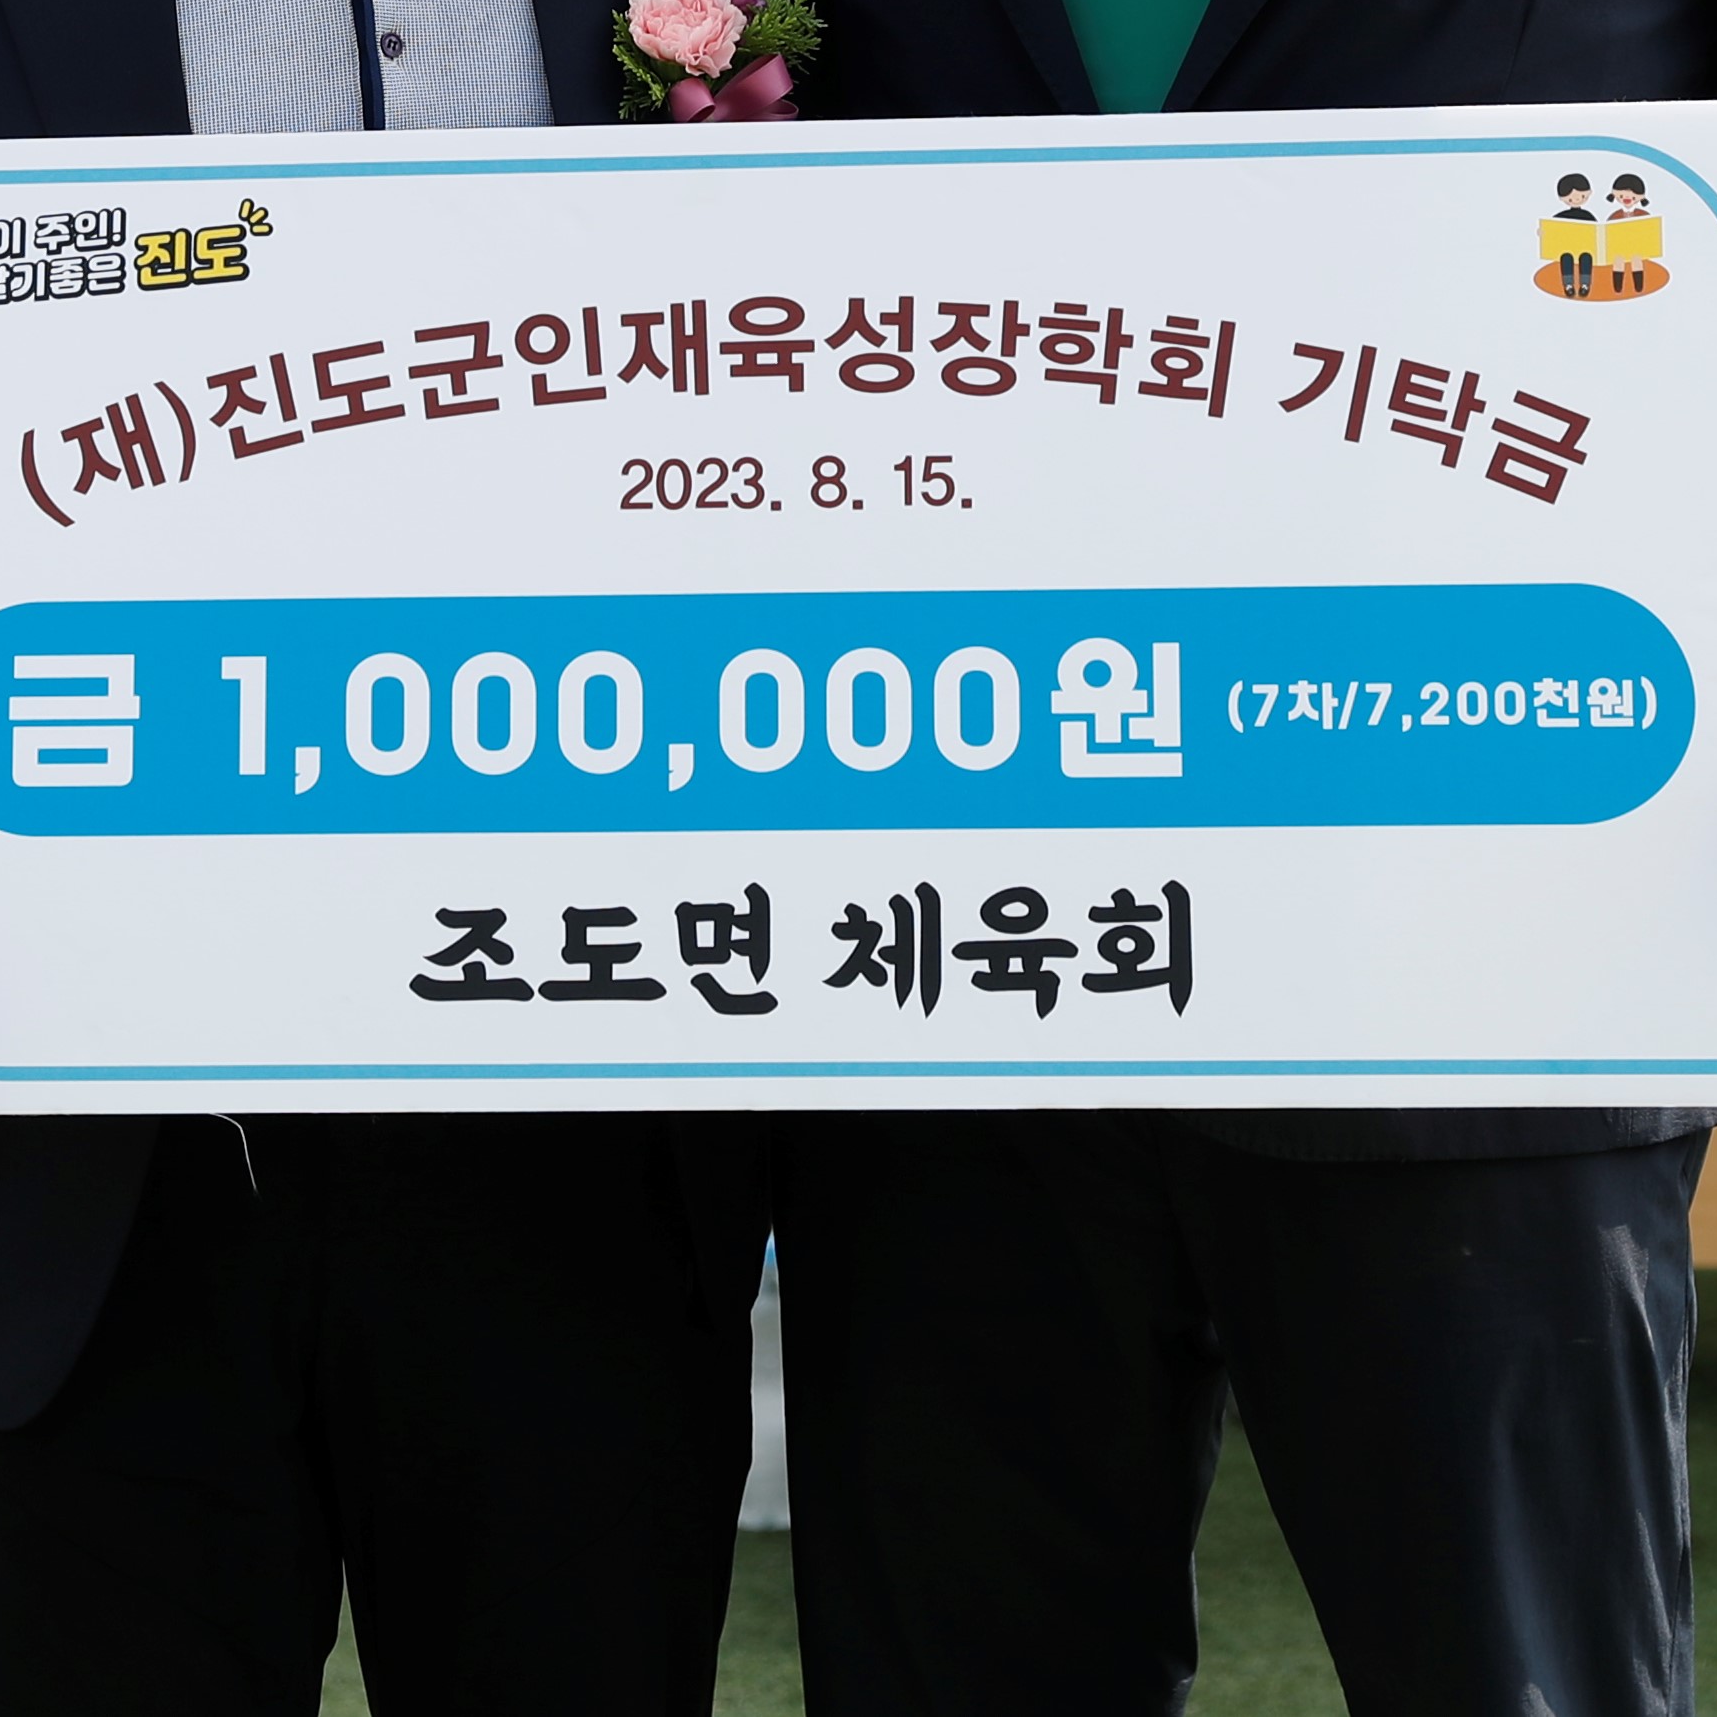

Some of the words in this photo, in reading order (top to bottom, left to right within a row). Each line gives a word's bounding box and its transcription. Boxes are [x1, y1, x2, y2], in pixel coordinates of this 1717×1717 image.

[33, 207, 127, 256] 주인!
[134, 224, 250, 291] 진도
[21, 295, 1237, 527] (재)진도군인재육성장학회
[1278, 342, 1591, 505] 기탁금
[619, 456, 782, 512] 2023.
[810, 455, 864, 511] 8.
[893, 455, 973, 509] 15.
[8, 654, 140, 787] 금
[221, 637, 1183, 795] 1,000,000원
[1228, 676, 1657, 733] (7차/7,200천원)
[408, 882, 779, 1016] 조도면
[822, 879, 1193, 1020] 체육회
